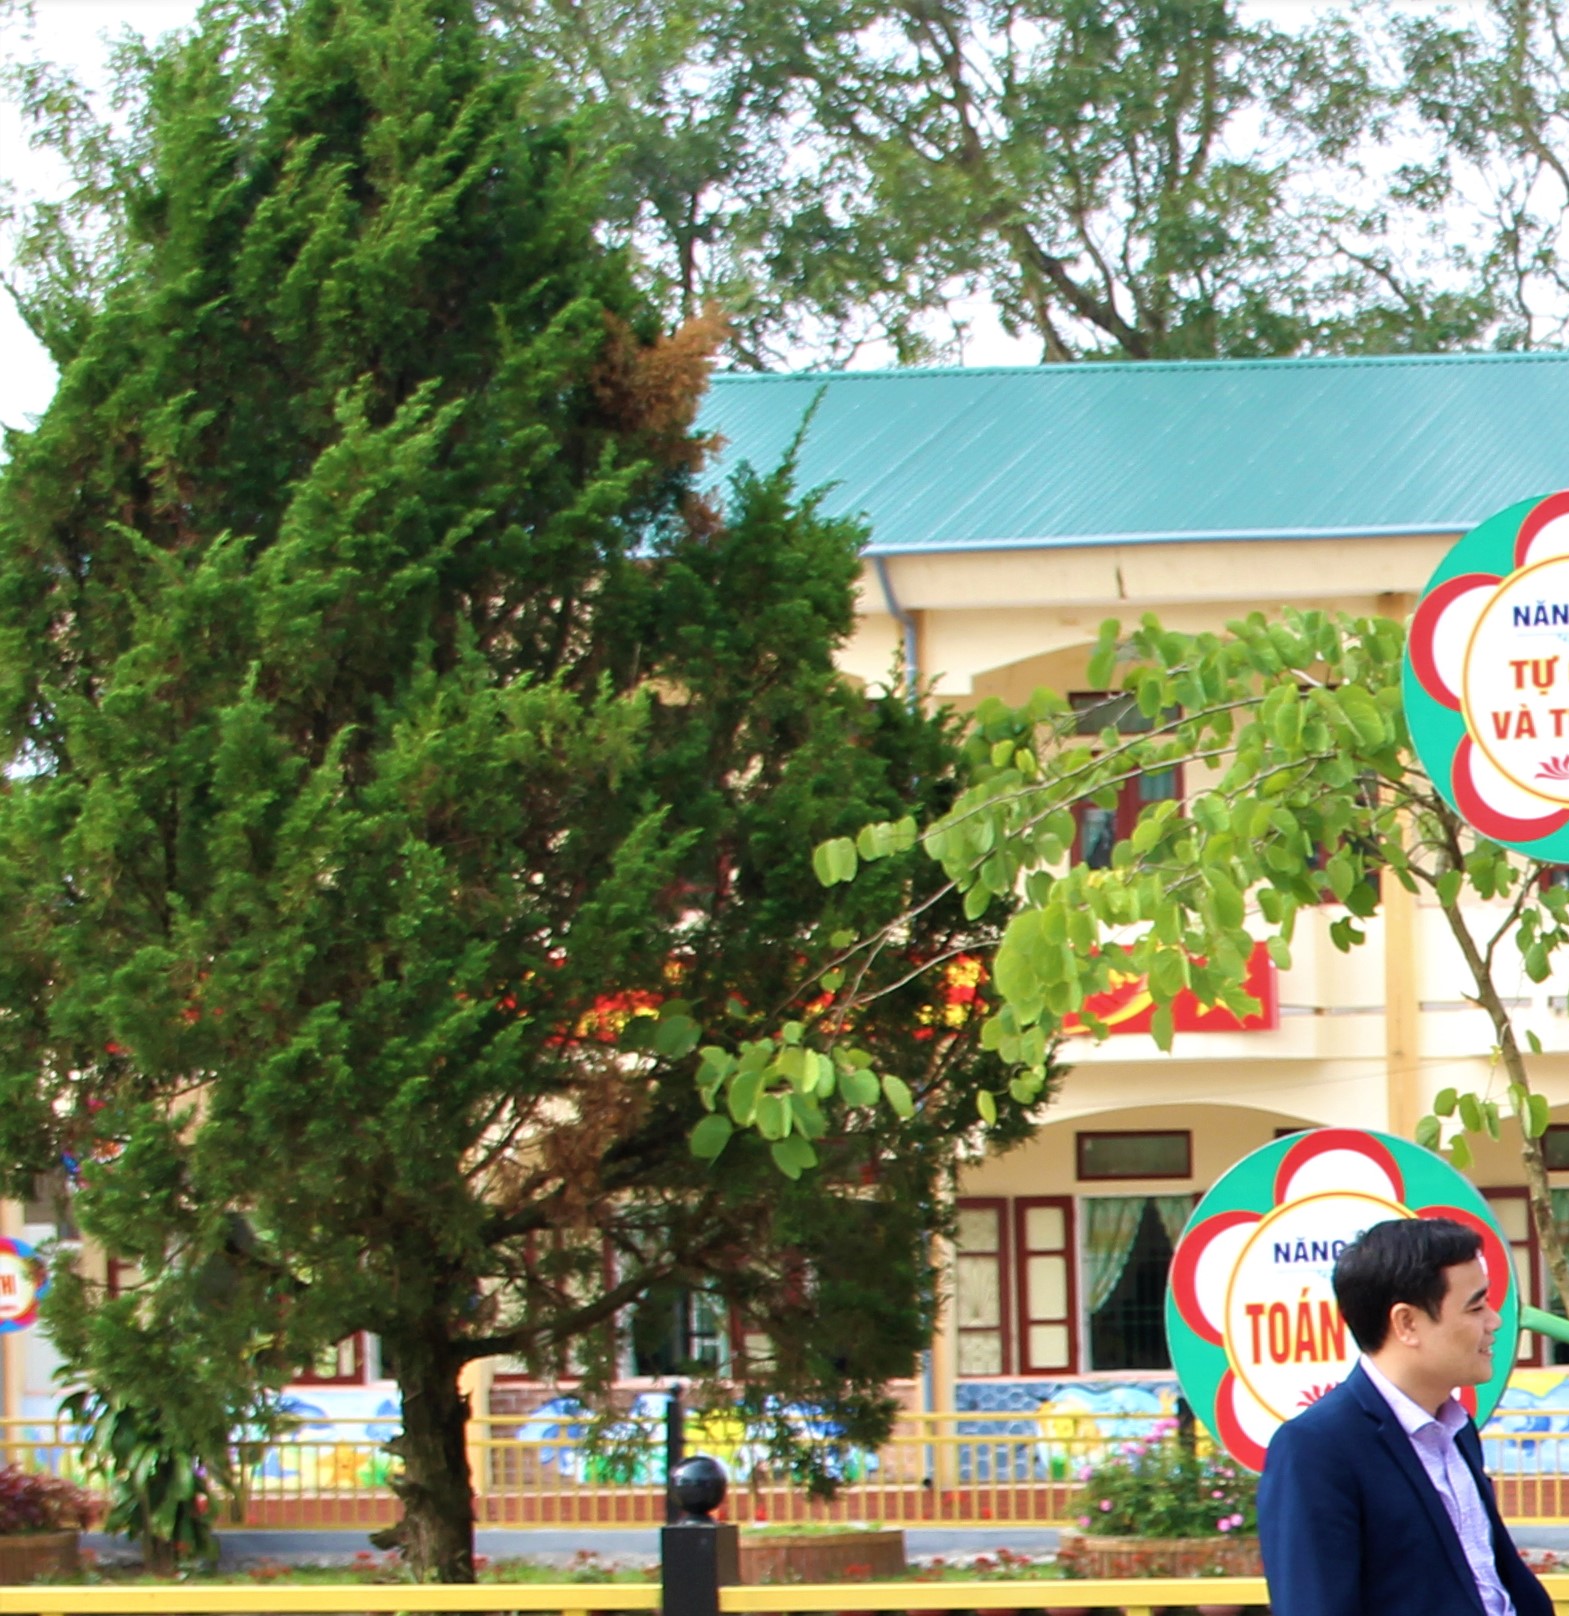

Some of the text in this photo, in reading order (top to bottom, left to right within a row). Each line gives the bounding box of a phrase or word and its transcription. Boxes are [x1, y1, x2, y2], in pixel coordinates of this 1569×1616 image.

[1509, 655, 1559, 695] TỰ
[1491, 704, 1537, 740] VÀ
[1245, 1287, 1347, 1366] TOÁN
